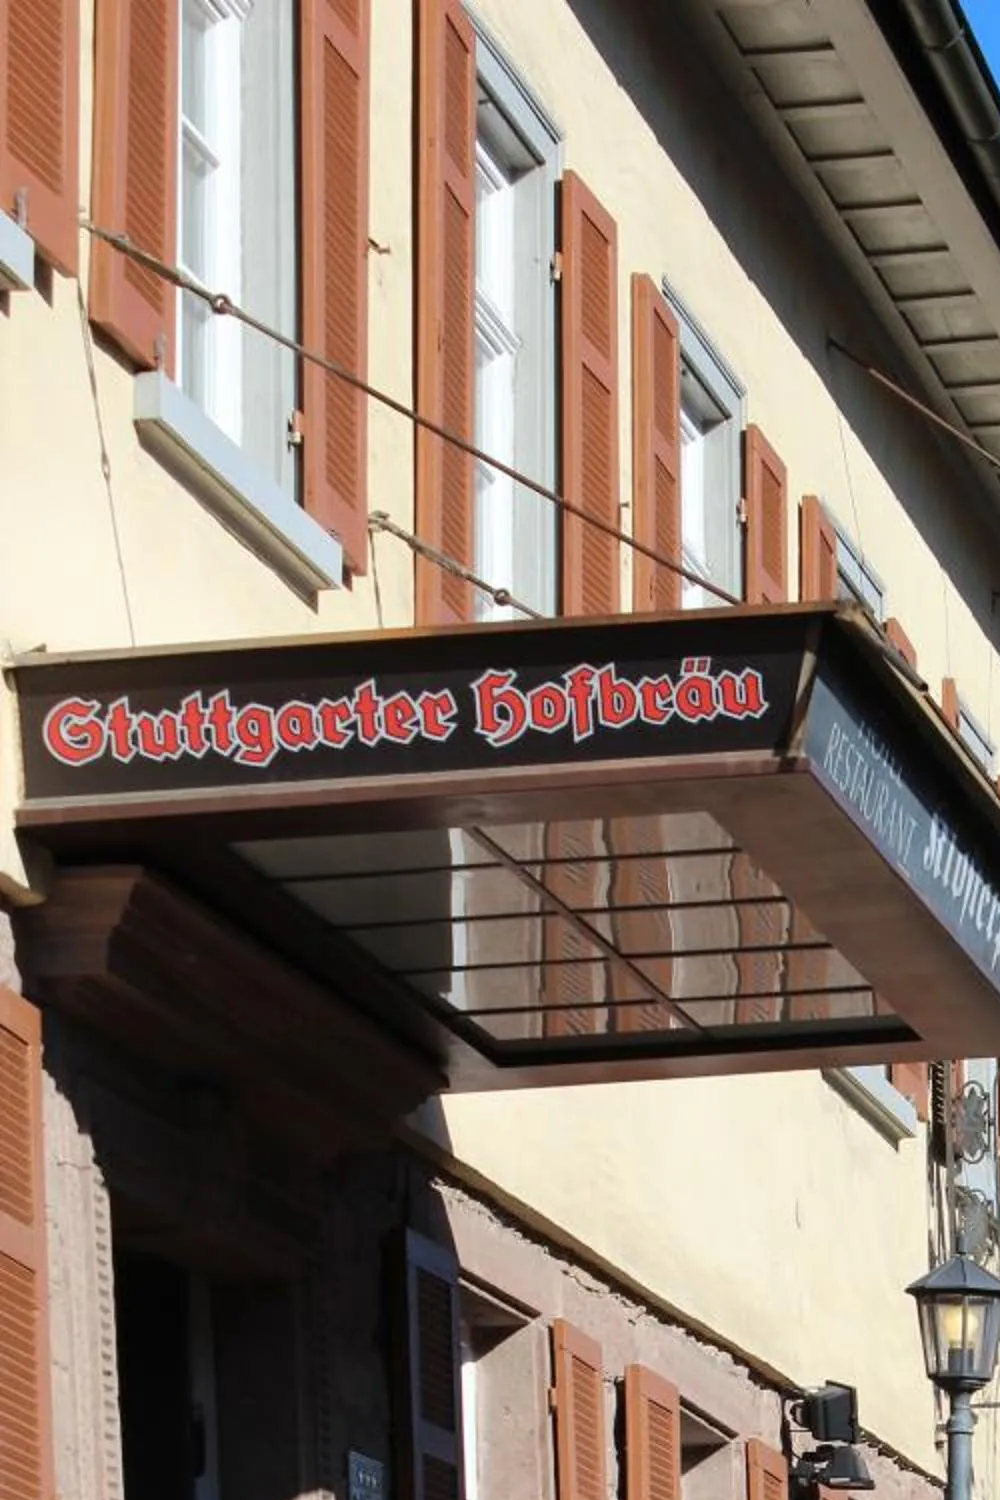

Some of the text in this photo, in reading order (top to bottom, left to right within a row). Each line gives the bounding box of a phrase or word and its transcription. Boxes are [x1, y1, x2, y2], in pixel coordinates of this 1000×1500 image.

[43, 656, 768, 767] Stuttgarter Hofbräu
[823, 721, 917, 867] RESTAURANT
